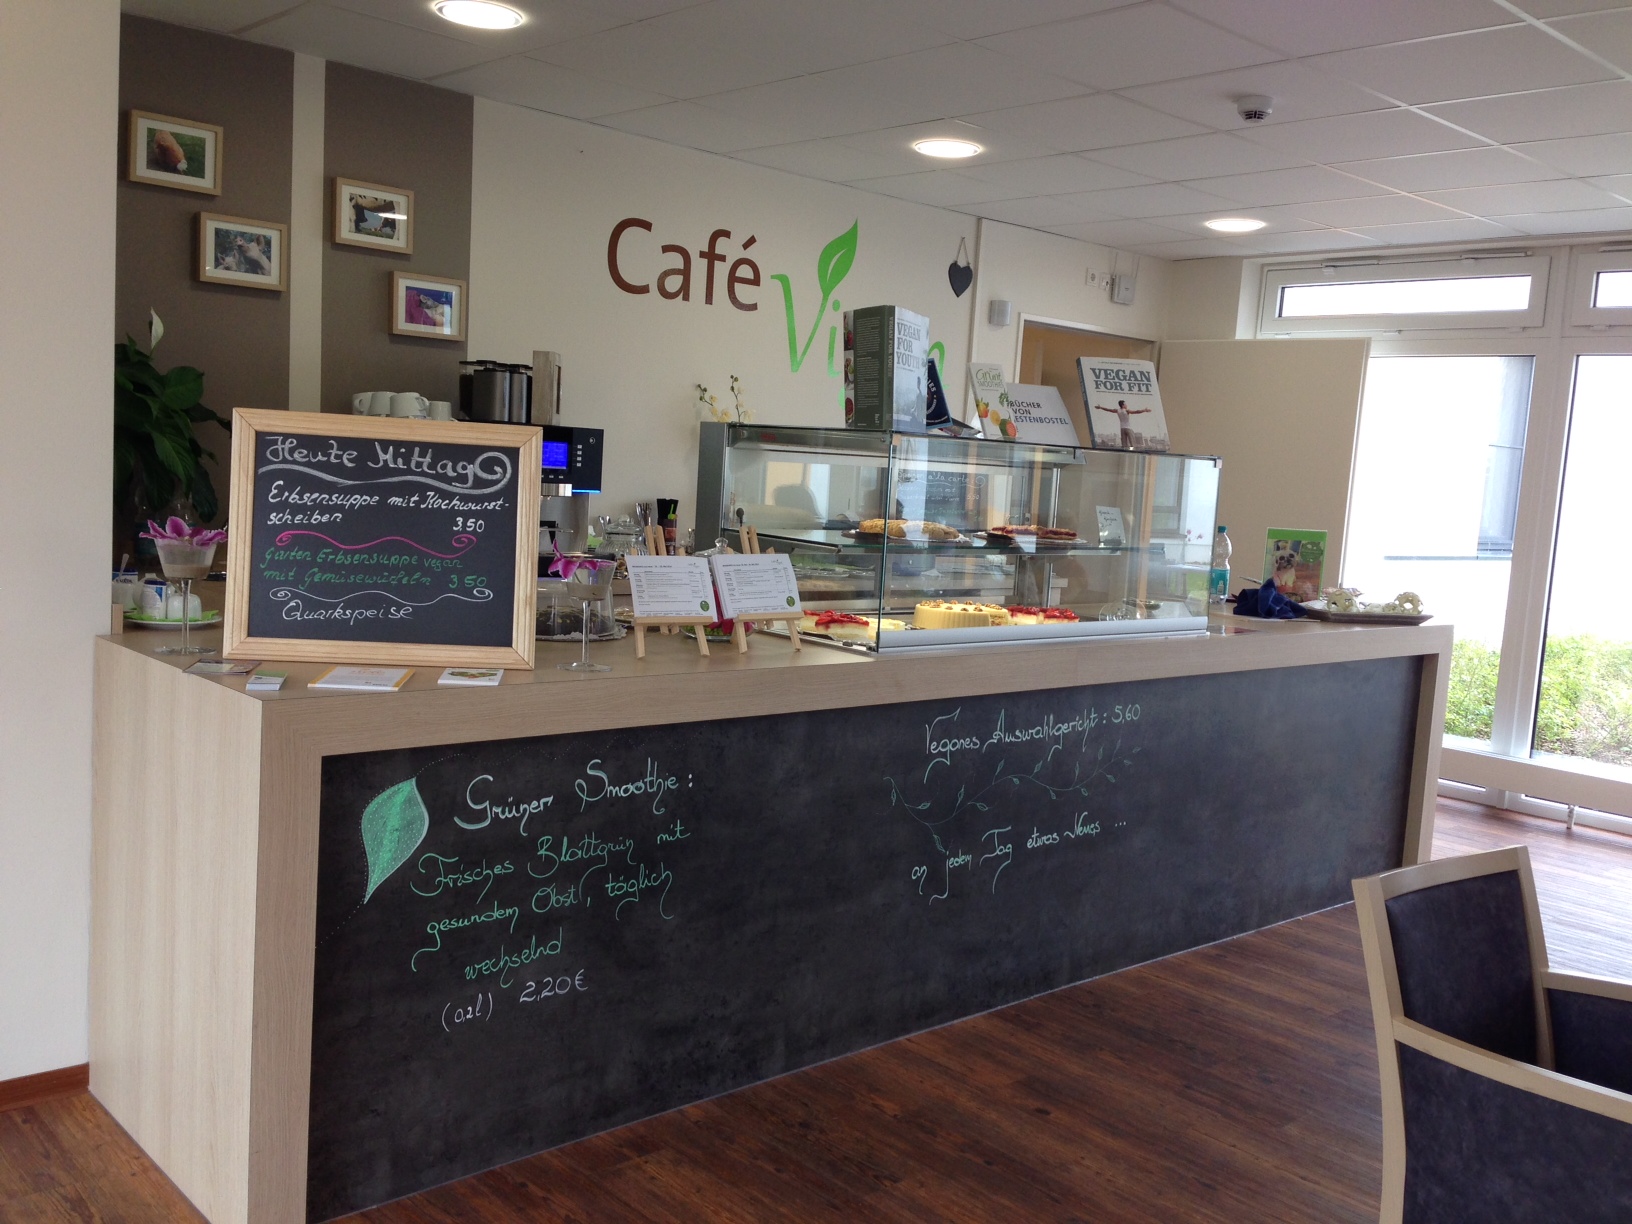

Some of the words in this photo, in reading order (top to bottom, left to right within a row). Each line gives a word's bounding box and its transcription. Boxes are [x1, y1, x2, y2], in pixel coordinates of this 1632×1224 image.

[607, 216, 761, 312] Café
[896, 321, 921, 342] VEGAN
[896, 337, 914, 354] FOR
[896, 350, 921, 370] YOUTH
[1090, 367, 1151, 383] VEGAN
[1093, 380, 1124, 391] FOR
[1127, 382, 1152, 393] FIT
[1010, 400, 1042, 409] BÜCHER
[1014, 415, 1069, 425] ESTENBOSTEL
[265, 436, 358, 467] Heute
[368, 441, 478, 488] Mittag
[267, 480, 380, 510] Erbsensuppe
[387, 492, 416, 508] mit
[420, 491, 510, 510] Kochwurst-
[267, 509, 343, 525] scheiben
[316, 549, 419, 571] Erbsensuppe
[423, 556, 464, 571] vegan
[264, 566, 297, 581] mit
[299, 567, 432, 590] Gemüsewürfeln
[282, 599, 414, 626] Quarkspeise
[924, 706, 980, 784] Veganes
[454, 774, 554, 837] Grüner
[410, 852, 515, 905] Frisches
[527, 831, 637, 899] Blattgrün
[657, 819, 691, 845] mit
[911, 865, 928, 895] an
[928, 851, 972, 906] jedem
[980, 825, 1013, 894] Tag
[1026, 827, 1060, 848] etwas
[1063, 811, 1101, 838] Neues
[411, 901, 519, 972] gesundem
[604, 861, 675, 922] täglich
[464, 926, 563, 989] wechselnd
